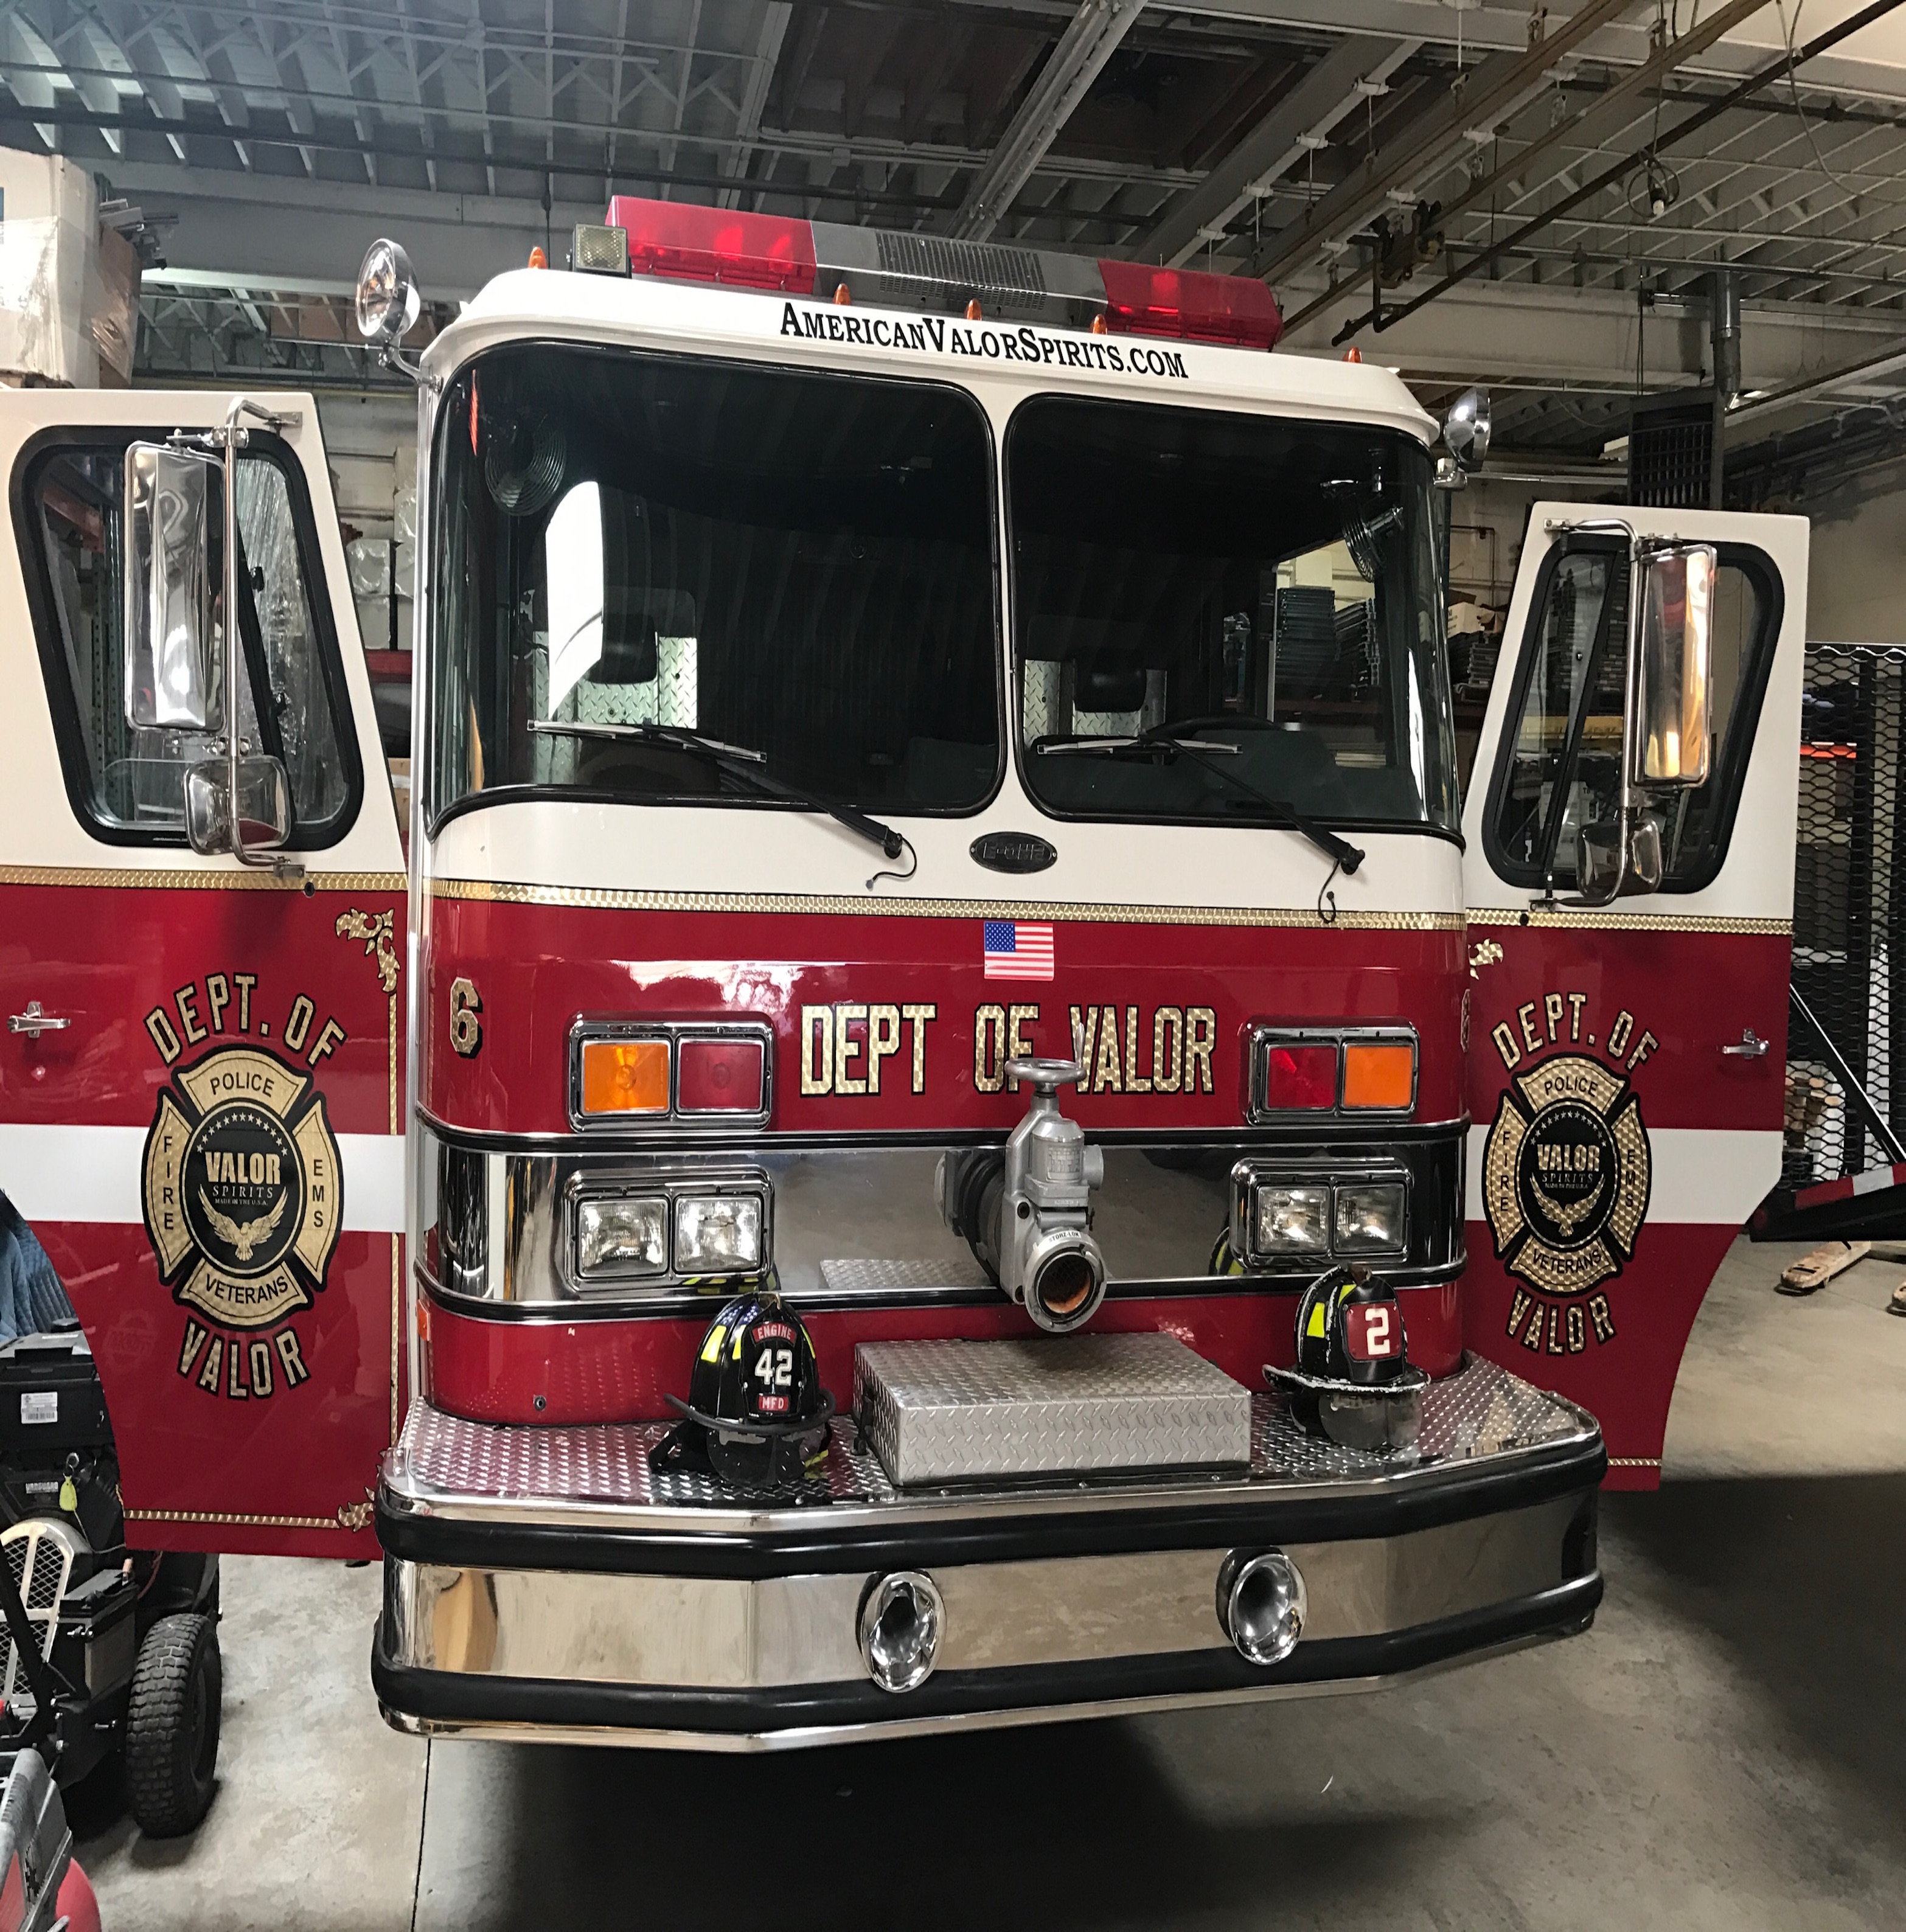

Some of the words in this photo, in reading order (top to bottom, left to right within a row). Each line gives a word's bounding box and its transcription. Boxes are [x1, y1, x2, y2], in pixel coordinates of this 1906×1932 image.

[144, 971, 270, 1067] DEPT.
[283, 993, 347, 1070] OF
[450, 976, 483, 1059] 6
[1490, 992, 1596, 1072] DEPT.
[1606, 1009, 1660, 1074] OF
[800, 1002, 938, 1097] DEPT
[972, 1002, 1040, 1096] OF
[1069, 1004, 1217, 1096] VALOR
[209, 1074, 276, 1098] POLICE
[1544, 1076, 1599, 1098] POLICE
[204, 1151, 281, 1185] VALOR
[1501, 1130, 1511, 1212] FIRE
[1537, 1144, 1600, 1172] VALOR
[1542, 1173, 1593, 1183] SPIRITS
[1626, 1149, 1636, 1208] EMS
[162, 1135, 174, 1231] FIRE
[212, 1185, 273, 1198] SPIRITS
[311, 1158, 325, 1228] EMS
[1532, 1248, 1602, 1275] VETERANS
[204, 1275, 289, 1304] VETERANS
[757, 1325, 792, 1340] ENGINE
[1365, 1307, 1391, 1356] 2
[1505, 1287, 1618, 1357] VALOR
[177, 1318, 310, 1400] VALOR
[754, 1348, 793, 1387] 42
[761, 1395, 785, 1409] MFD
